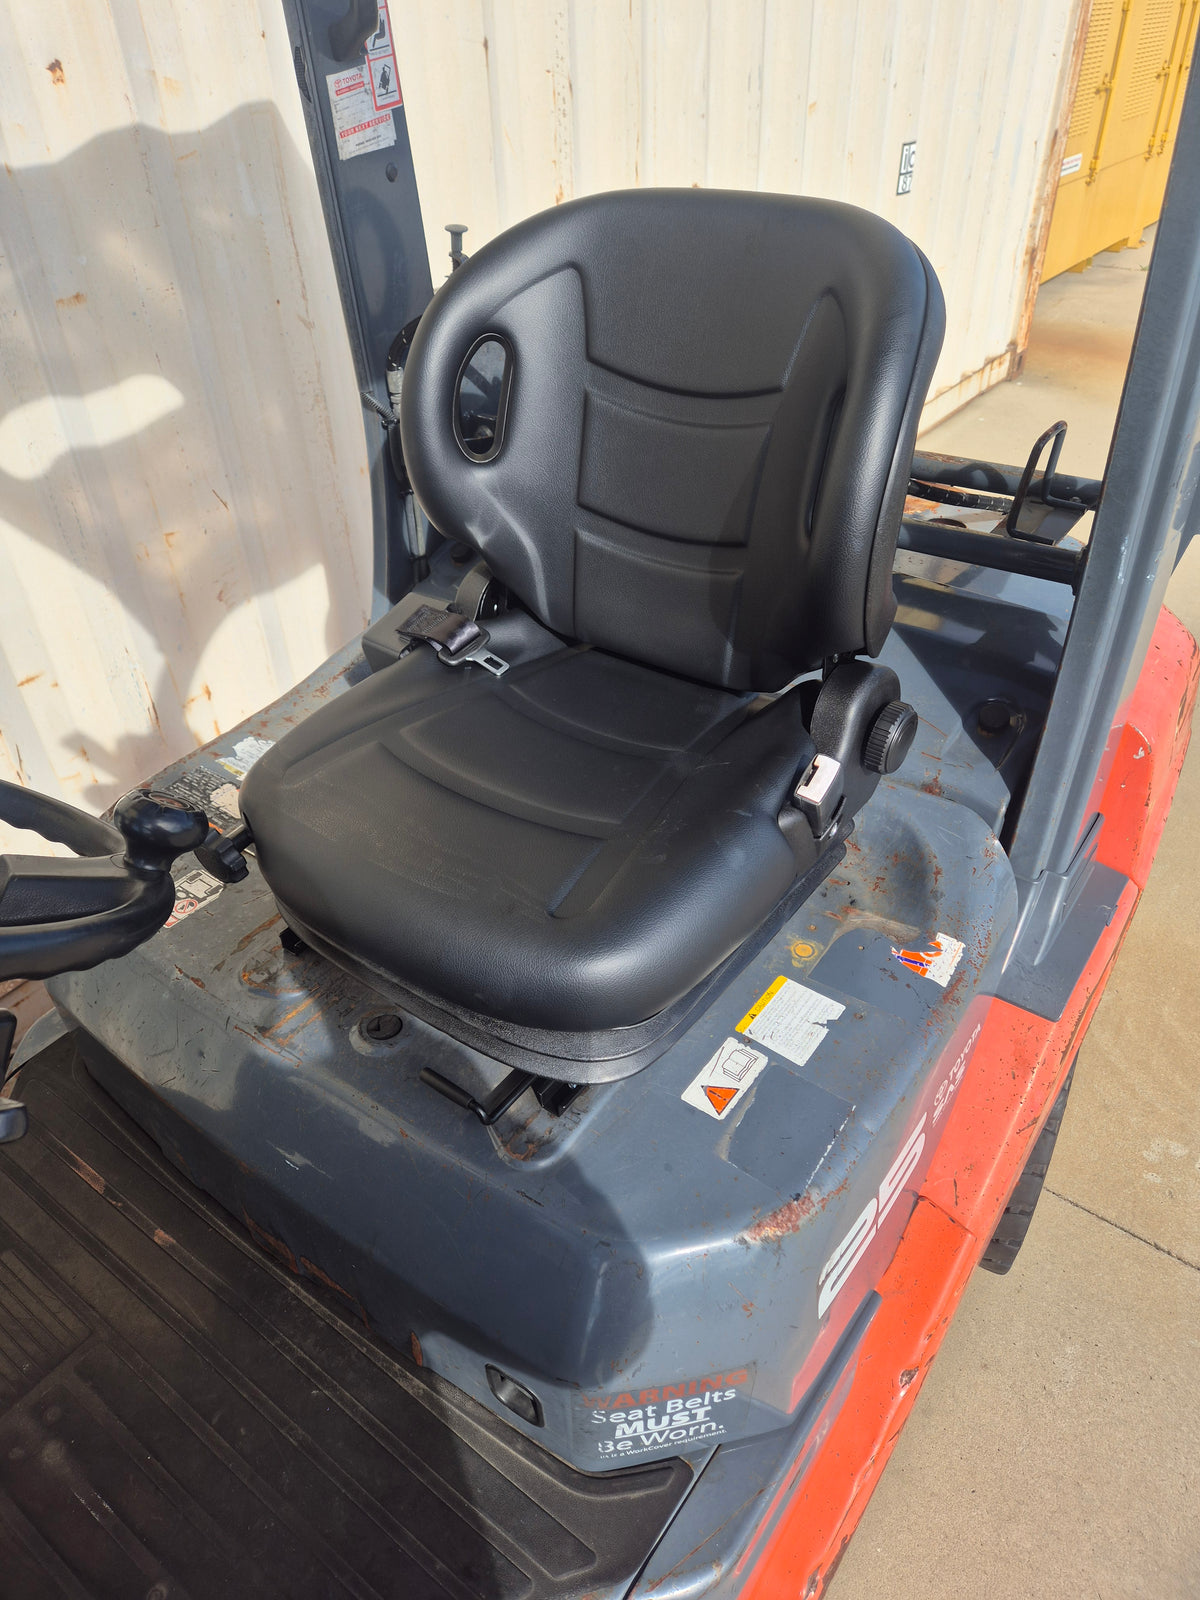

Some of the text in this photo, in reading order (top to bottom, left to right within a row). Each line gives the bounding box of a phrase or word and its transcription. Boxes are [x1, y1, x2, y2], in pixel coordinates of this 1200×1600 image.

[341, 73, 363, 85] TOYOTA
[341, 114, 391, 138] YOUR NEXT SERVICE
[948, 1023, 981, 1080] TOYOTA
[818, 1112, 928, 1320] 25
[582, 1369, 749, 1410] WARNING
[591, 1389, 737, 1424] Seat Belts
[615, 1406, 712, 1437] MUST
[598, 1422, 725, 1453] Be Worn.
[625, 1442, 673, 1456] WorkCover
